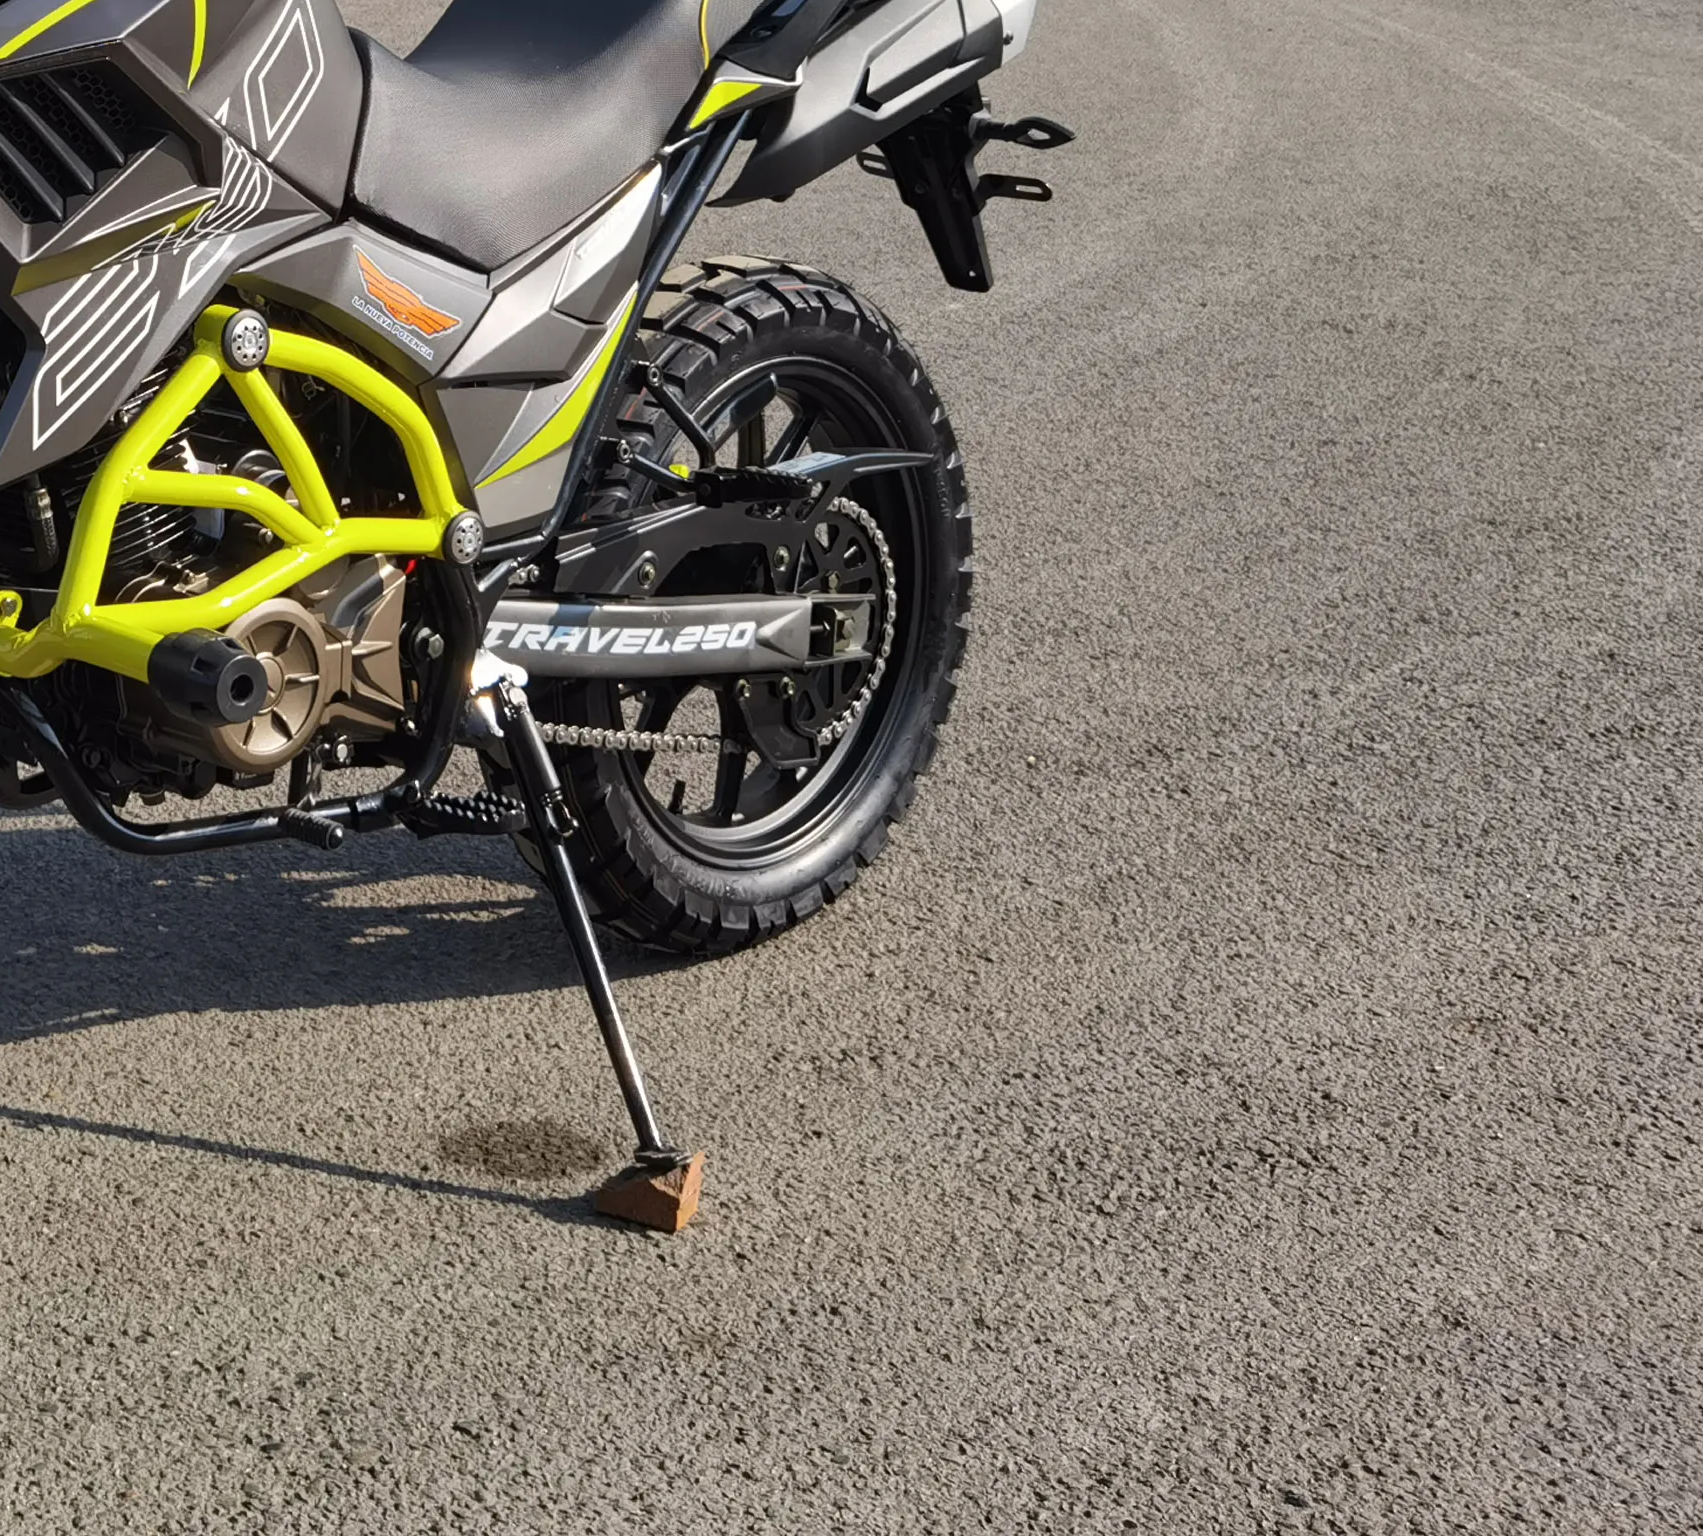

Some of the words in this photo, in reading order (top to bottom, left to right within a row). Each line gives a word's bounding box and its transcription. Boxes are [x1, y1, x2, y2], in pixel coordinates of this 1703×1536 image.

[352, 296, 365, 310] LA
[364, 306, 392, 331] NUEVA
[392, 324, 434, 360] POTENCIA
[484, 620, 758, 654] TRAVEL250
